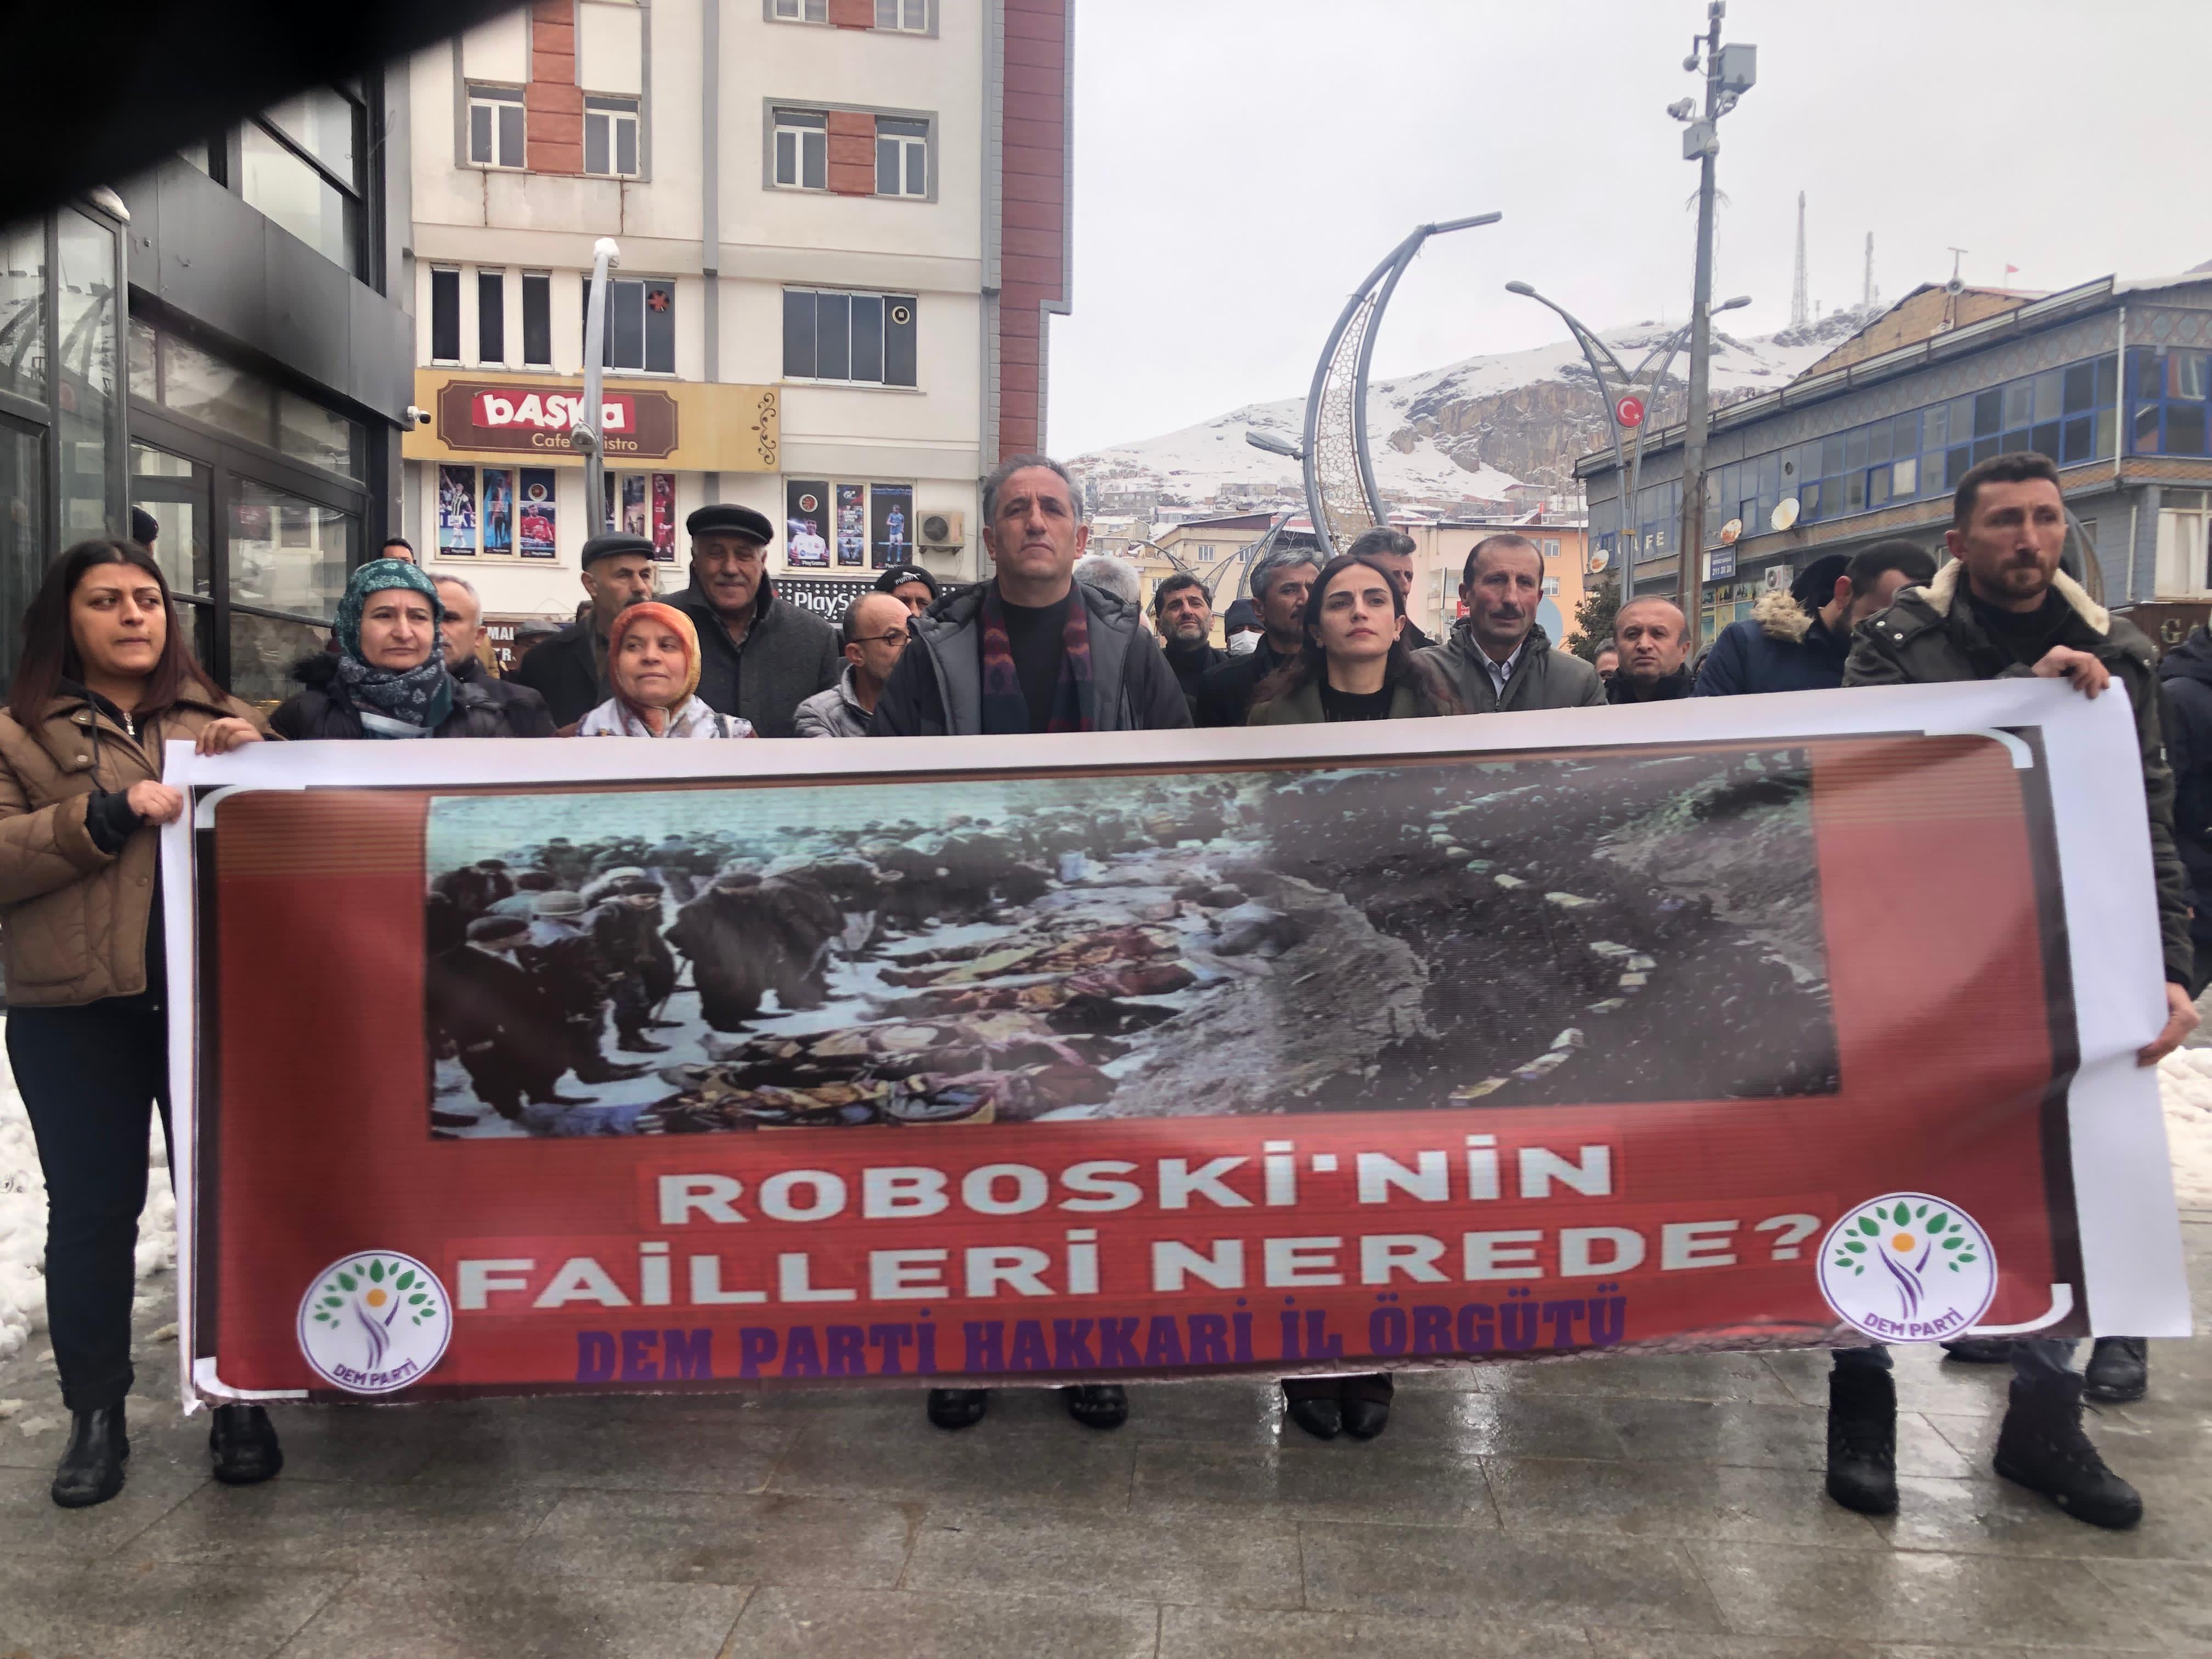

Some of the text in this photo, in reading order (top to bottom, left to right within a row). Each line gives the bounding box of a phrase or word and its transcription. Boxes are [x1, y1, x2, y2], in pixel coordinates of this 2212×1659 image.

[532, 433, 639, 450] Cafe istro
[795, 591, 856, 616] PlayS
[458, 1214, 1821, 1310] FAİLLERİ NEREDE?
[576, 1282, 1627, 1383] DEM PARTİ HAKKARİ İL ÖRGÜTÜ
[1863, 1306, 1965, 1337] DEM PARTİ
[333, 1363, 368, 1386] DEM
